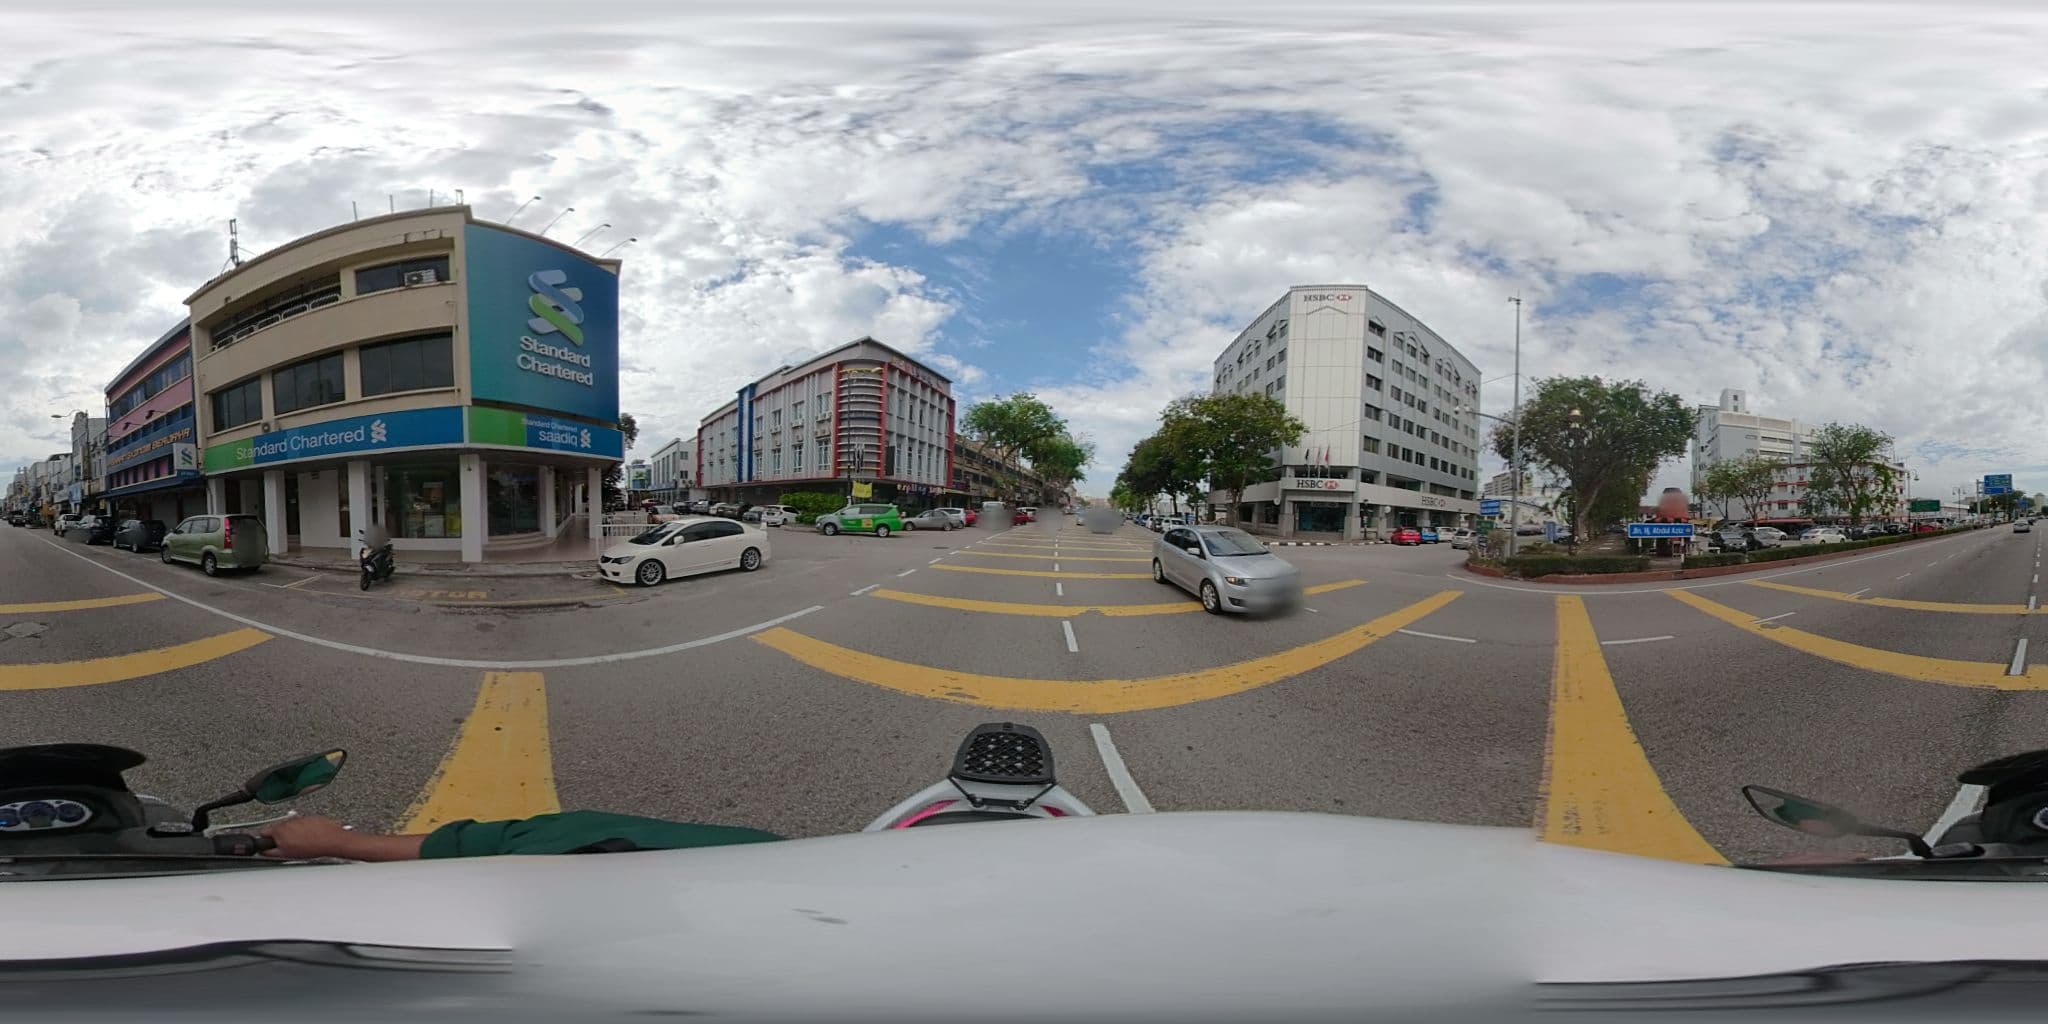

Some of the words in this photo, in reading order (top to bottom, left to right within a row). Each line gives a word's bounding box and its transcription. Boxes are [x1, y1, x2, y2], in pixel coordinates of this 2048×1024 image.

[1303, 294, 1335, 302] HSBC
[519, 335, 591, 368] Standard
[516, 353, 593, 386] Chartered
[236, 438, 288, 461] Standard
[290, 425, 365, 451] Chartered
[538, 430, 578, 448] saadiq
[1296, 480, 1324, 489] HSBC
[1421, 496, 1439, 507] HSBC
